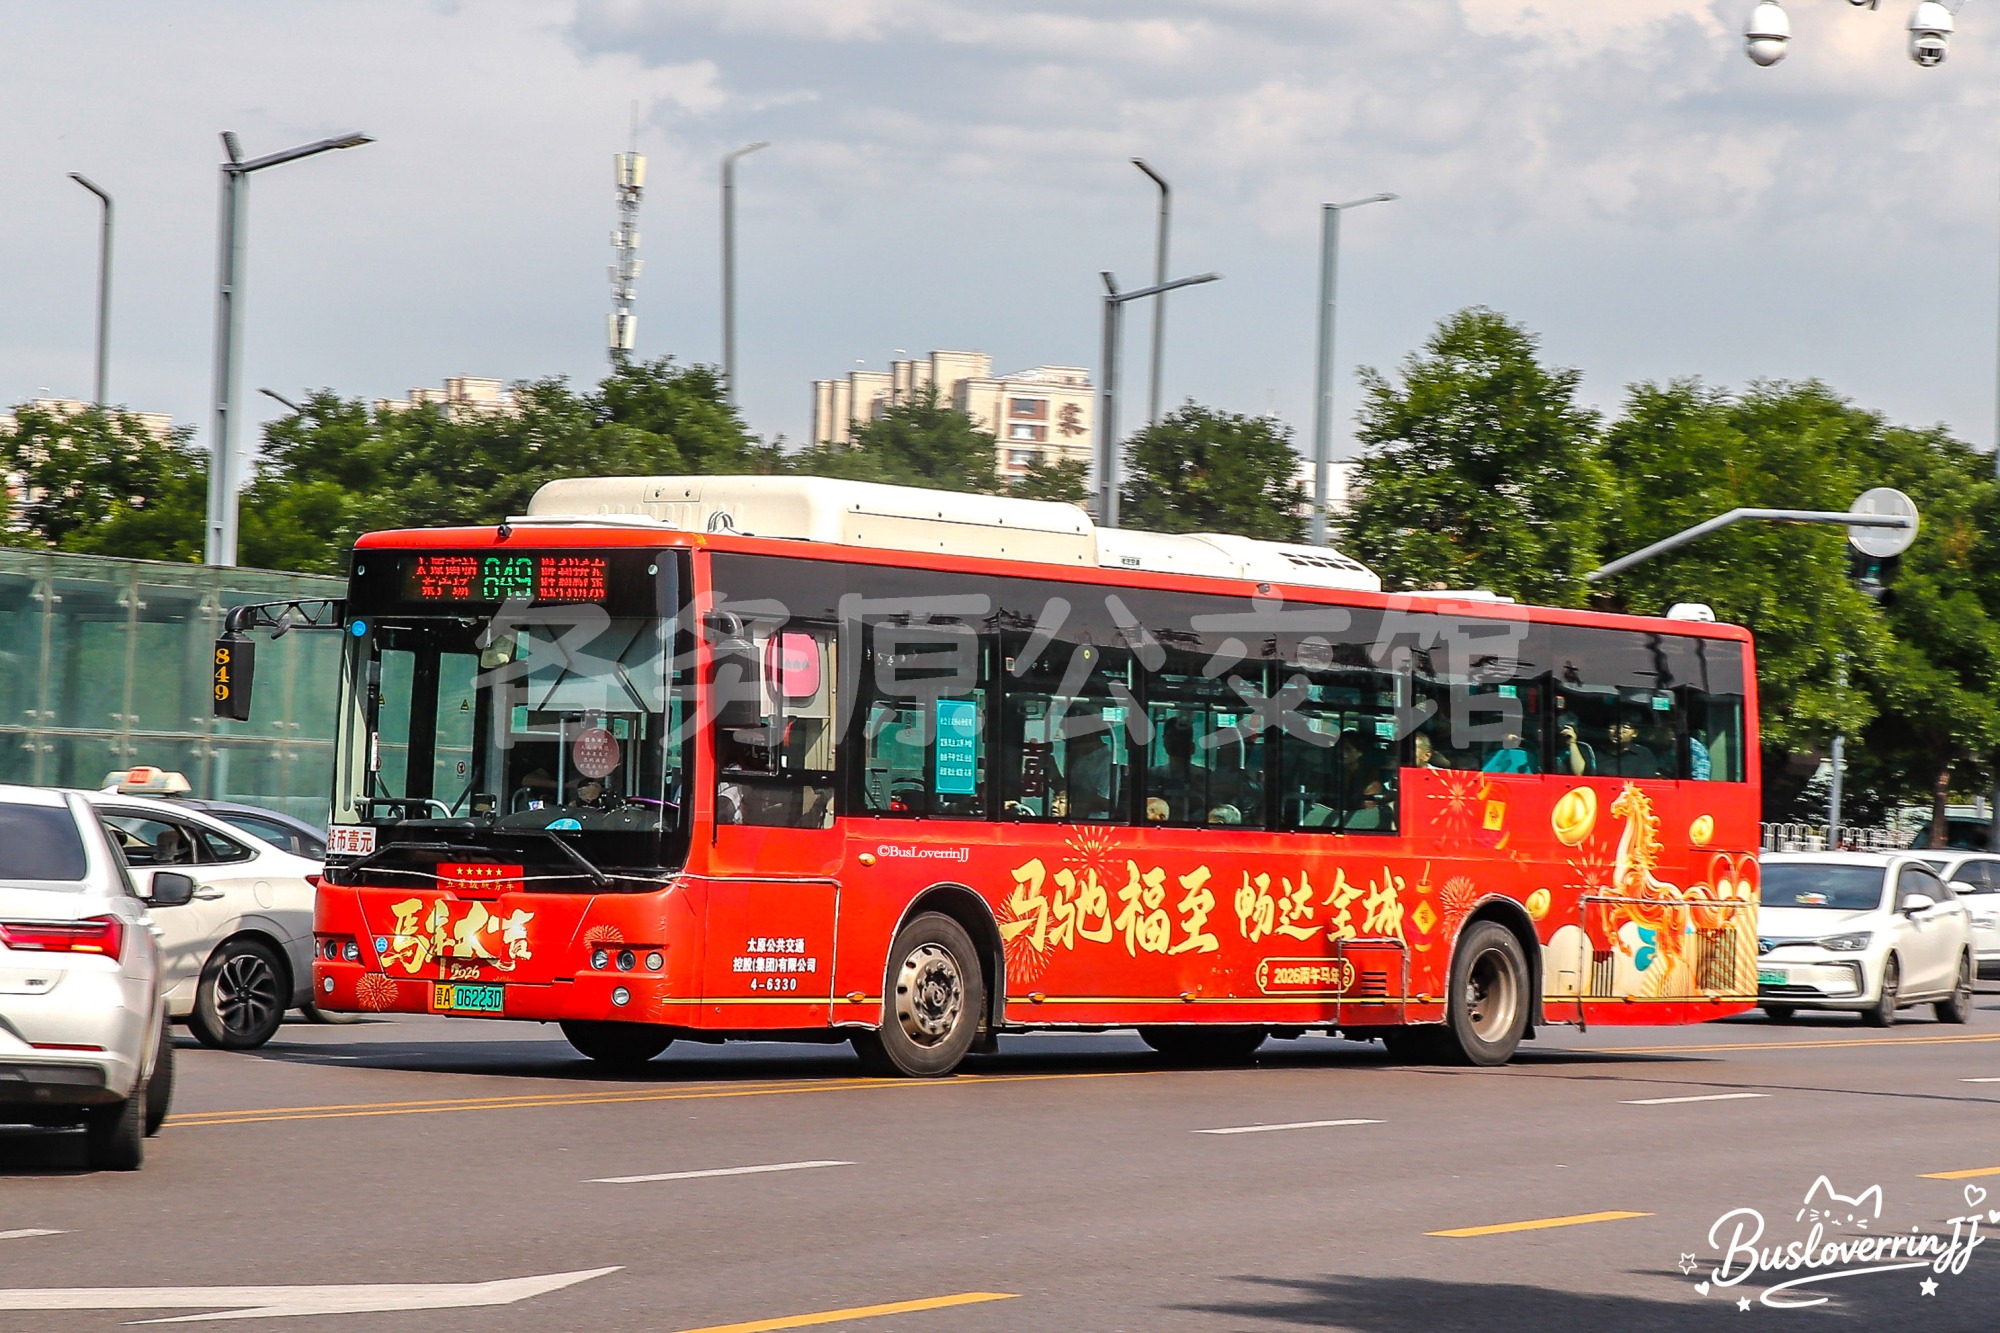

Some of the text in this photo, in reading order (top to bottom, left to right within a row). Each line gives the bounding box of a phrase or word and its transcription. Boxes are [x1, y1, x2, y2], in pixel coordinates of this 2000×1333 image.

[214, 648, 231, 701] 849
[1000, 857, 1408, 958] 马驰福至 畅达全城
[747, 937, 805, 953] 太原公共交通
[450, 963, 481, 981] 2026
[750, 978, 797, 991] 4-6330
